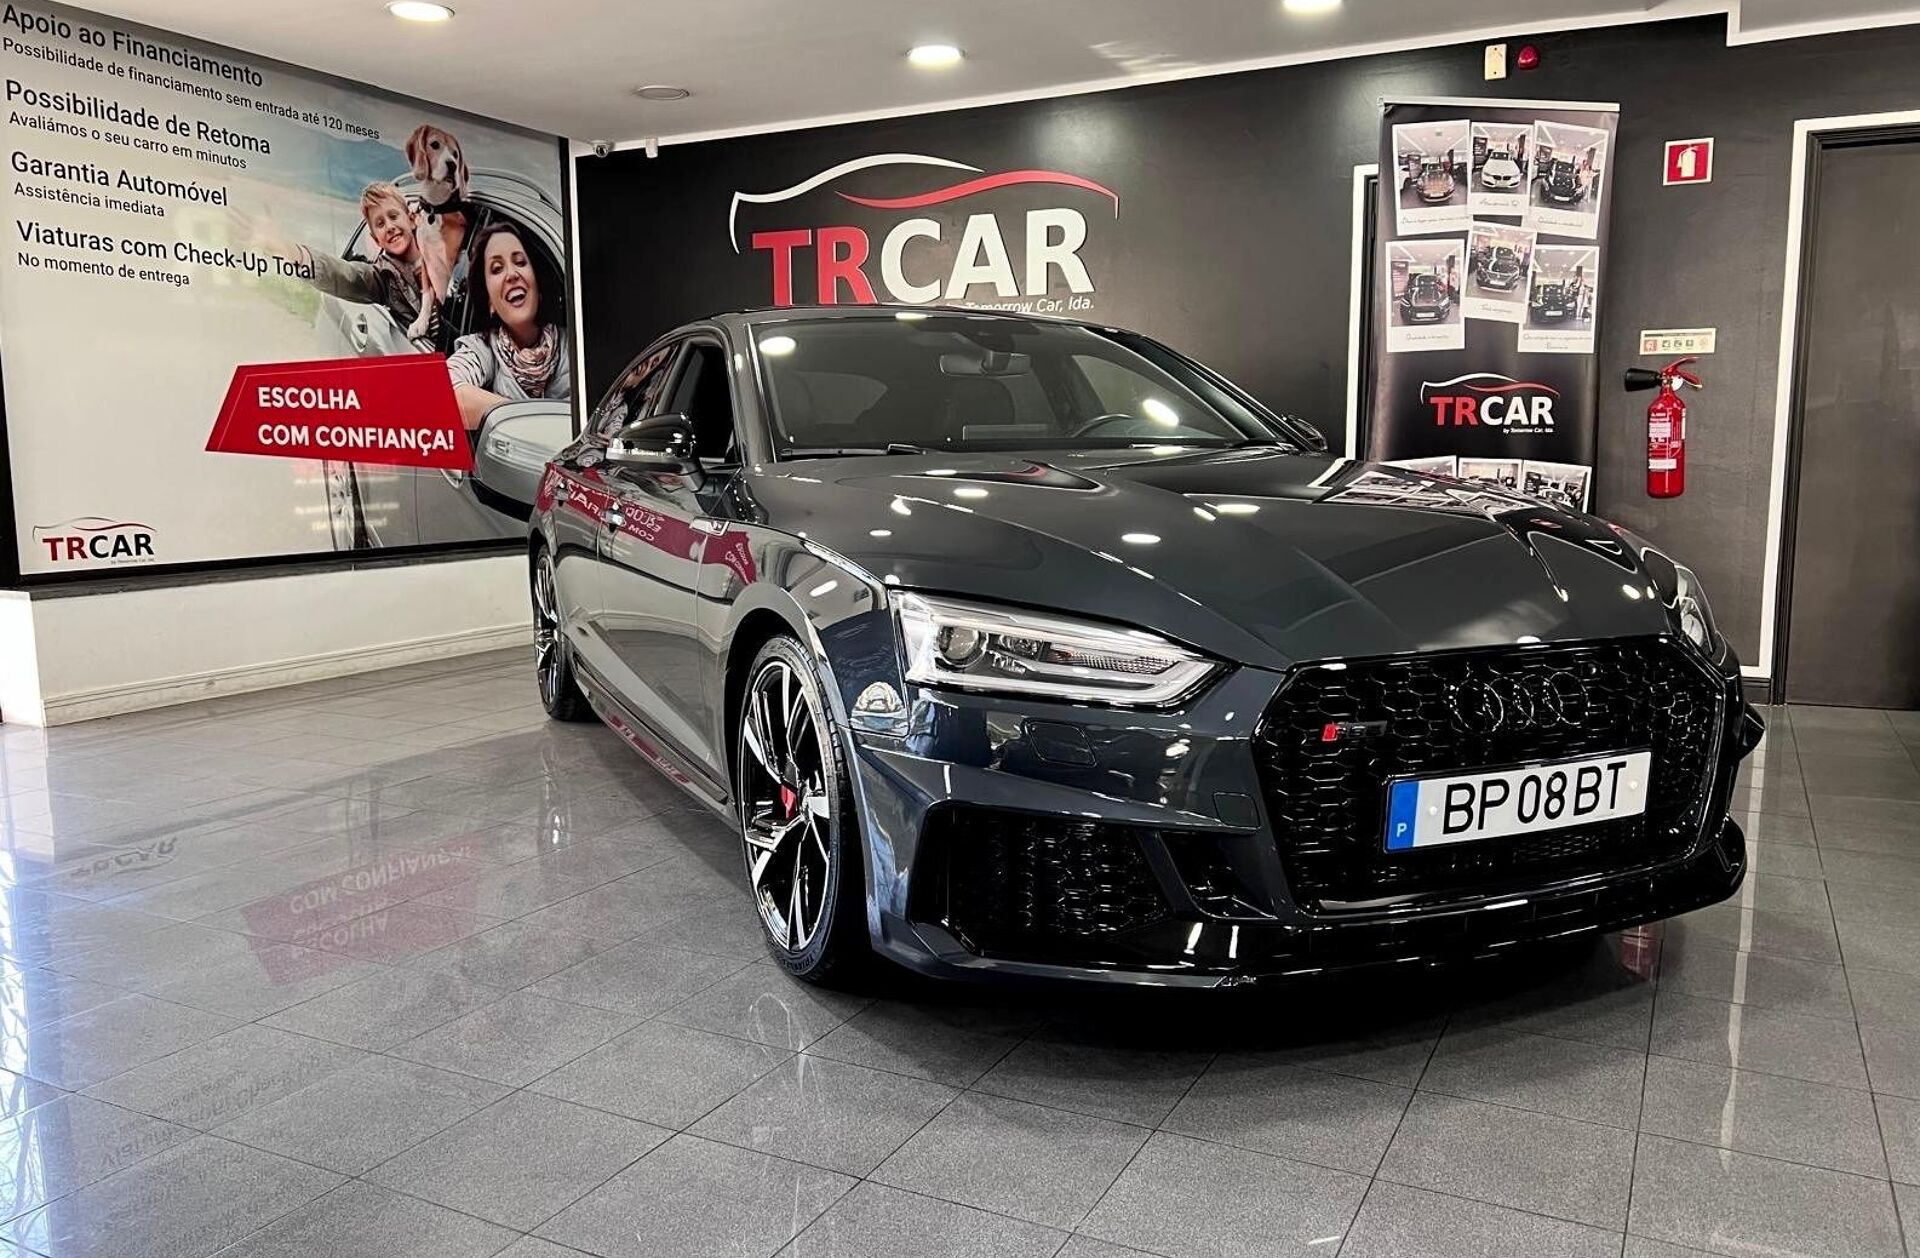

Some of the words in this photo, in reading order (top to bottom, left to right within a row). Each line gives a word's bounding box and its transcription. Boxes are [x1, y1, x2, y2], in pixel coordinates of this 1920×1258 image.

[3, 4, 71, 38] Apoio
[79, 27, 106, 47] ao
[113, 31, 262, 87] Financiamento
[3, 37, 103, 71] Possibilidade
[108, 62, 125, 77] de
[129, 66, 223, 101] financiamento
[226, 92, 251, 108] sem
[255, 101, 299, 120] entrada
[302, 110, 319, 125] até
[322, 115, 342, 130] 120
[345, 121, 380, 140] meses
[6, 80, 159, 130] Possibilidade
[165, 115, 190, 136] de
[197, 121, 270, 154] Retoma
[9, 111, 87, 138] Avaliámos
[92, 130, 100, 140] o
[105, 132, 129, 146] seu
[134, 137, 168, 154] carro
[172, 145, 192, 158] em
[196, 149, 247, 170] minutos
[11, 151, 110, 186] Garantia
[116, 170, 228, 206] Automóvel
[14, 182, 100, 207] Assistência
[105, 196, 164, 217] imediata
[16, 220, 114, 252] Viaturas
[120, 238, 167, 260] com
[174, 243, 268, 277] Check-Up
[272, 256, 316, 280] Total
[18, 252, 40, 267] No
[44, 258, 114, 277] momento
[118, 264, 135, 278] de
[139, 269, 190, 287] entrega
[752, 208, 1095, 306] TRCAR
[258, 386, 360, 410] ESCOLHA
[1430, 396, 1554, 426] TRCAR
[258, 424, 310, 446] COM
[316, 427, 455, 456] CONFIANÇA!
[43, 533, 154, 561] TRCAR
[1395, 821, 1407, 838] P
[1442, 778, 1509, 835] BP
[1517, 771, 1567, 825] 08
[1573, 760, 1627, 816] BT
